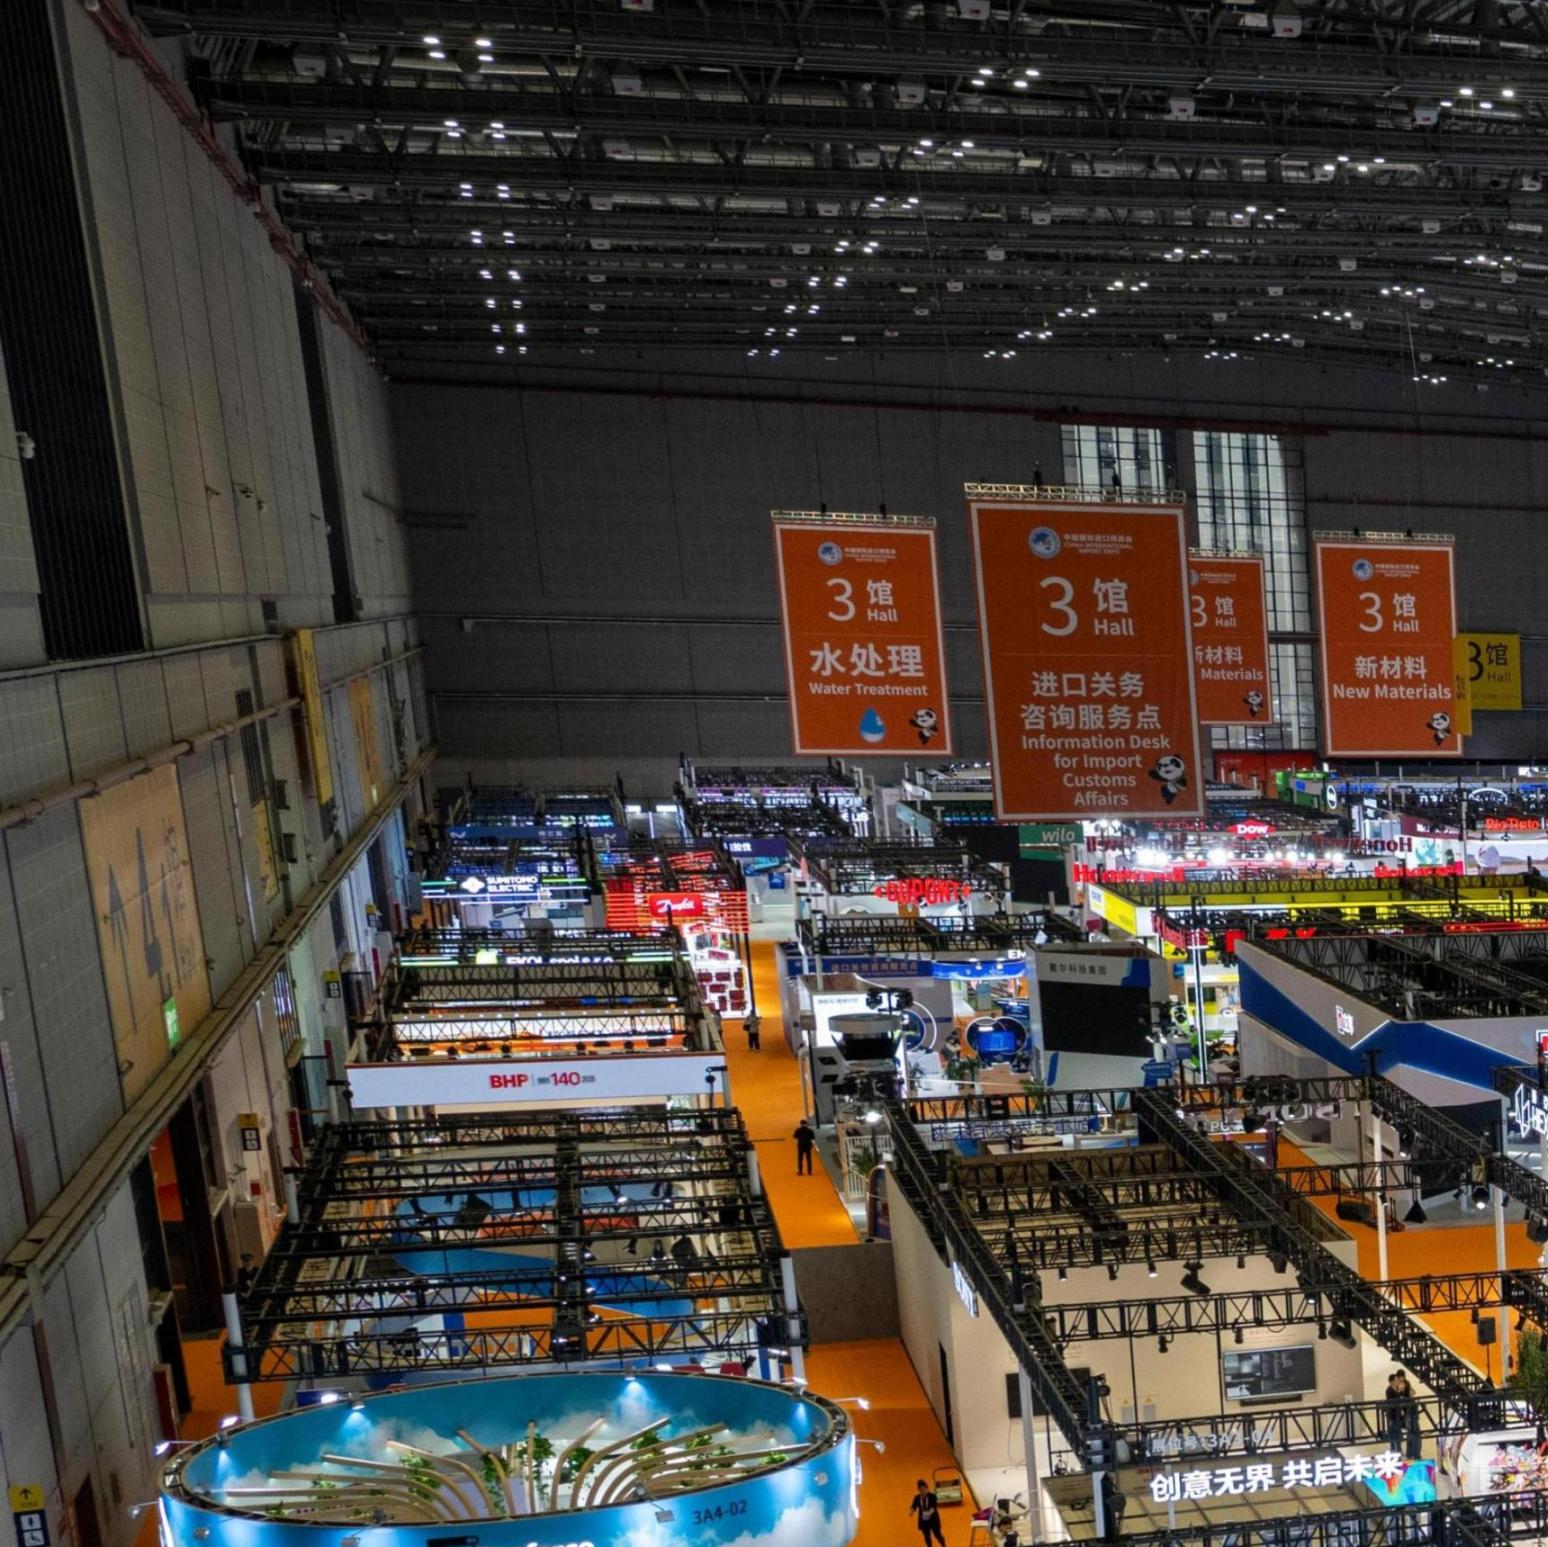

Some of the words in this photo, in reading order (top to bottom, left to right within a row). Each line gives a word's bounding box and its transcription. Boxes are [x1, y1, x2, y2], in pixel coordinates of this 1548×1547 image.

[826, 577, 857, 622] 3
[866, 579, 894, 606] 馆
[1039, 576, 1078, 637] 3
[1092, 578, 1129, 614] 馆
[1215, 596, 1234, 616] 馆
[867, 608, 898, 622] Hall
[1359, 592, 1383, 632] 3
[1393, 593, 1416, 617] 馆
[1094, 618, 1134, 636] Hall
[1215, 617, 1237, 628] Hall
[1392, 620, 1420, 633] Hall
[809, 642, 925, 678] 水处理
[1485, 643, 1509, 666] 馆
[1201, 667, 1264, 681] Materials
[1355, 655, 1428, 680] 新材料
[1032, 671, 1145, 698] 进口关务
[1487, 671, 1512, 684] Hall
[809, 682, 851, 695] Water
[854, 683, 929, 697] Treatment
[1333, 684, 1371, 699] New
[1375, 685, 1451, 700] Materials
[1020, 704, 1162, 731] 咨询服务点
[1021, 735, 1126, 750] Information
[1129, 735, 1170, 750] Desk
[1054, 754, 1079, 768] for
[1083, 754, 1142, 771] Import
[1062, 772, 1137, 788] Customs
[1074, 791, 1129, 807] Affairs
[1041, 828, 1076, 842] wilo
[486, 876, 538, 885] SUMITOMO
[487, 885, 534, 893] ELECTRIC
[489, 1073, 529, 1089] BHP
[550, 1071, 581, 1087] 140
[1149, 1464, 1274, 1504] 创意无界
[1282, 1451, 1403, 1491] 共启未来
[692, 1499, 748, 1526] 3A4-02
